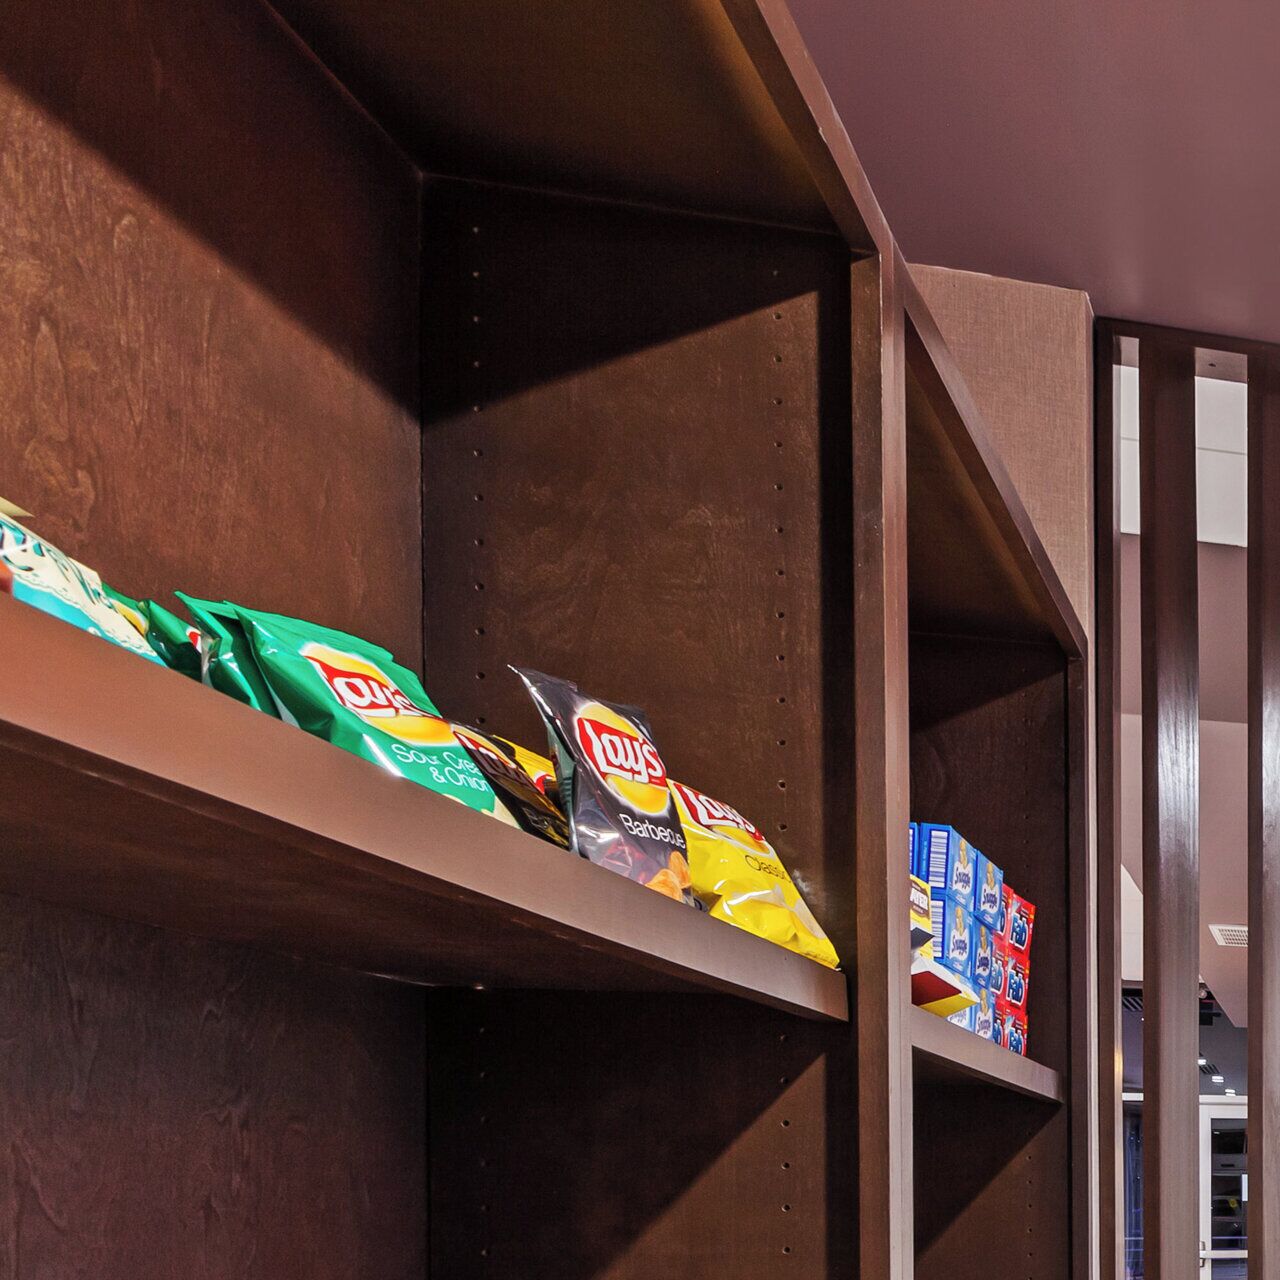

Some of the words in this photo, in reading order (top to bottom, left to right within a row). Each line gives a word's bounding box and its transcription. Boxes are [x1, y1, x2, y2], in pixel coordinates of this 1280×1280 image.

[391, 743, 441, 765] Sour
[443, 751, 484, 776] Crea
[583, 719, 664, 784] Lay's
[431, 767, 445, 784] &
[680, 785, 756, 834] Lay's
[619, 813, 686, 850] Barbecue
